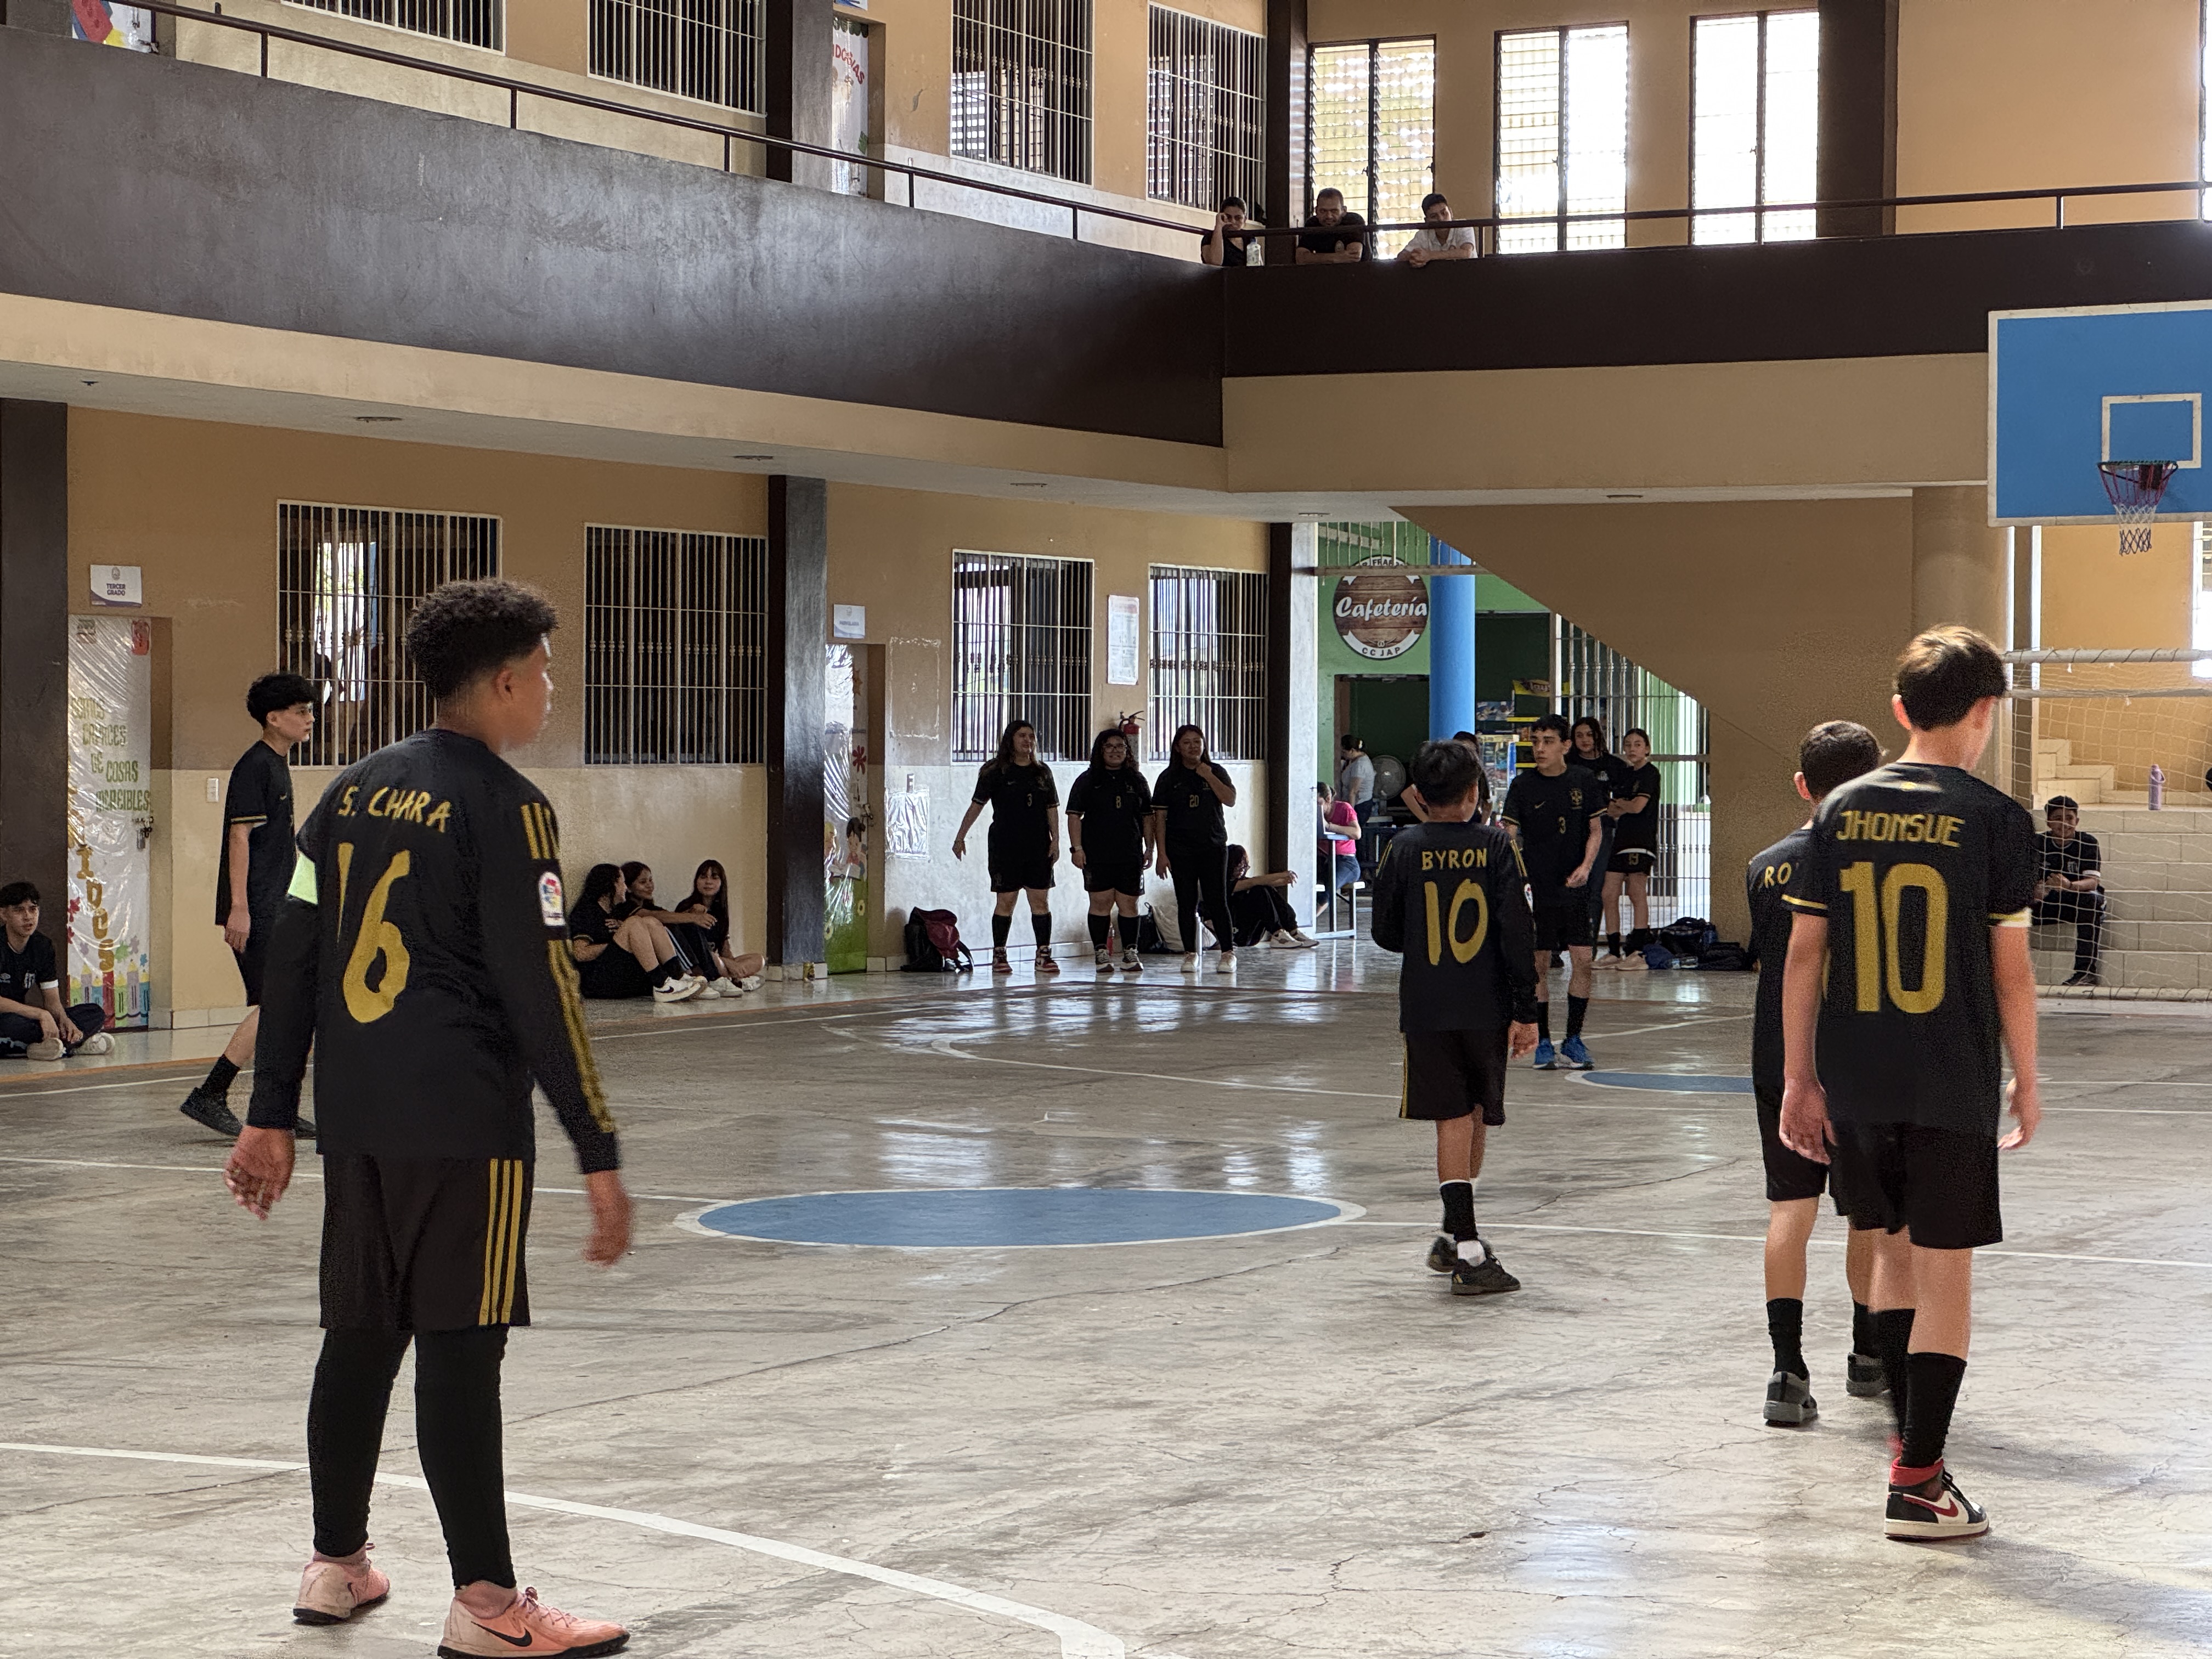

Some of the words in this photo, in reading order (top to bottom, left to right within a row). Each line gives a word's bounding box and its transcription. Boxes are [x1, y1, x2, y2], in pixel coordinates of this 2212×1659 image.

[1335, 596, 1427, 621] Cafetería
[106, 760, 138, 783] COSAS
[368, 787, 451, 833] CHARA
[1189, 794, 1199, 808] 20
[1559, 816, 1566, 834] 3
[1836, 810, 1965, 848] JHONSUE
[1421, 848, 1488, 871] BYRON
[1424, 879, 1489, 966] 10
[1839, 861, 1949, 1014] 10
